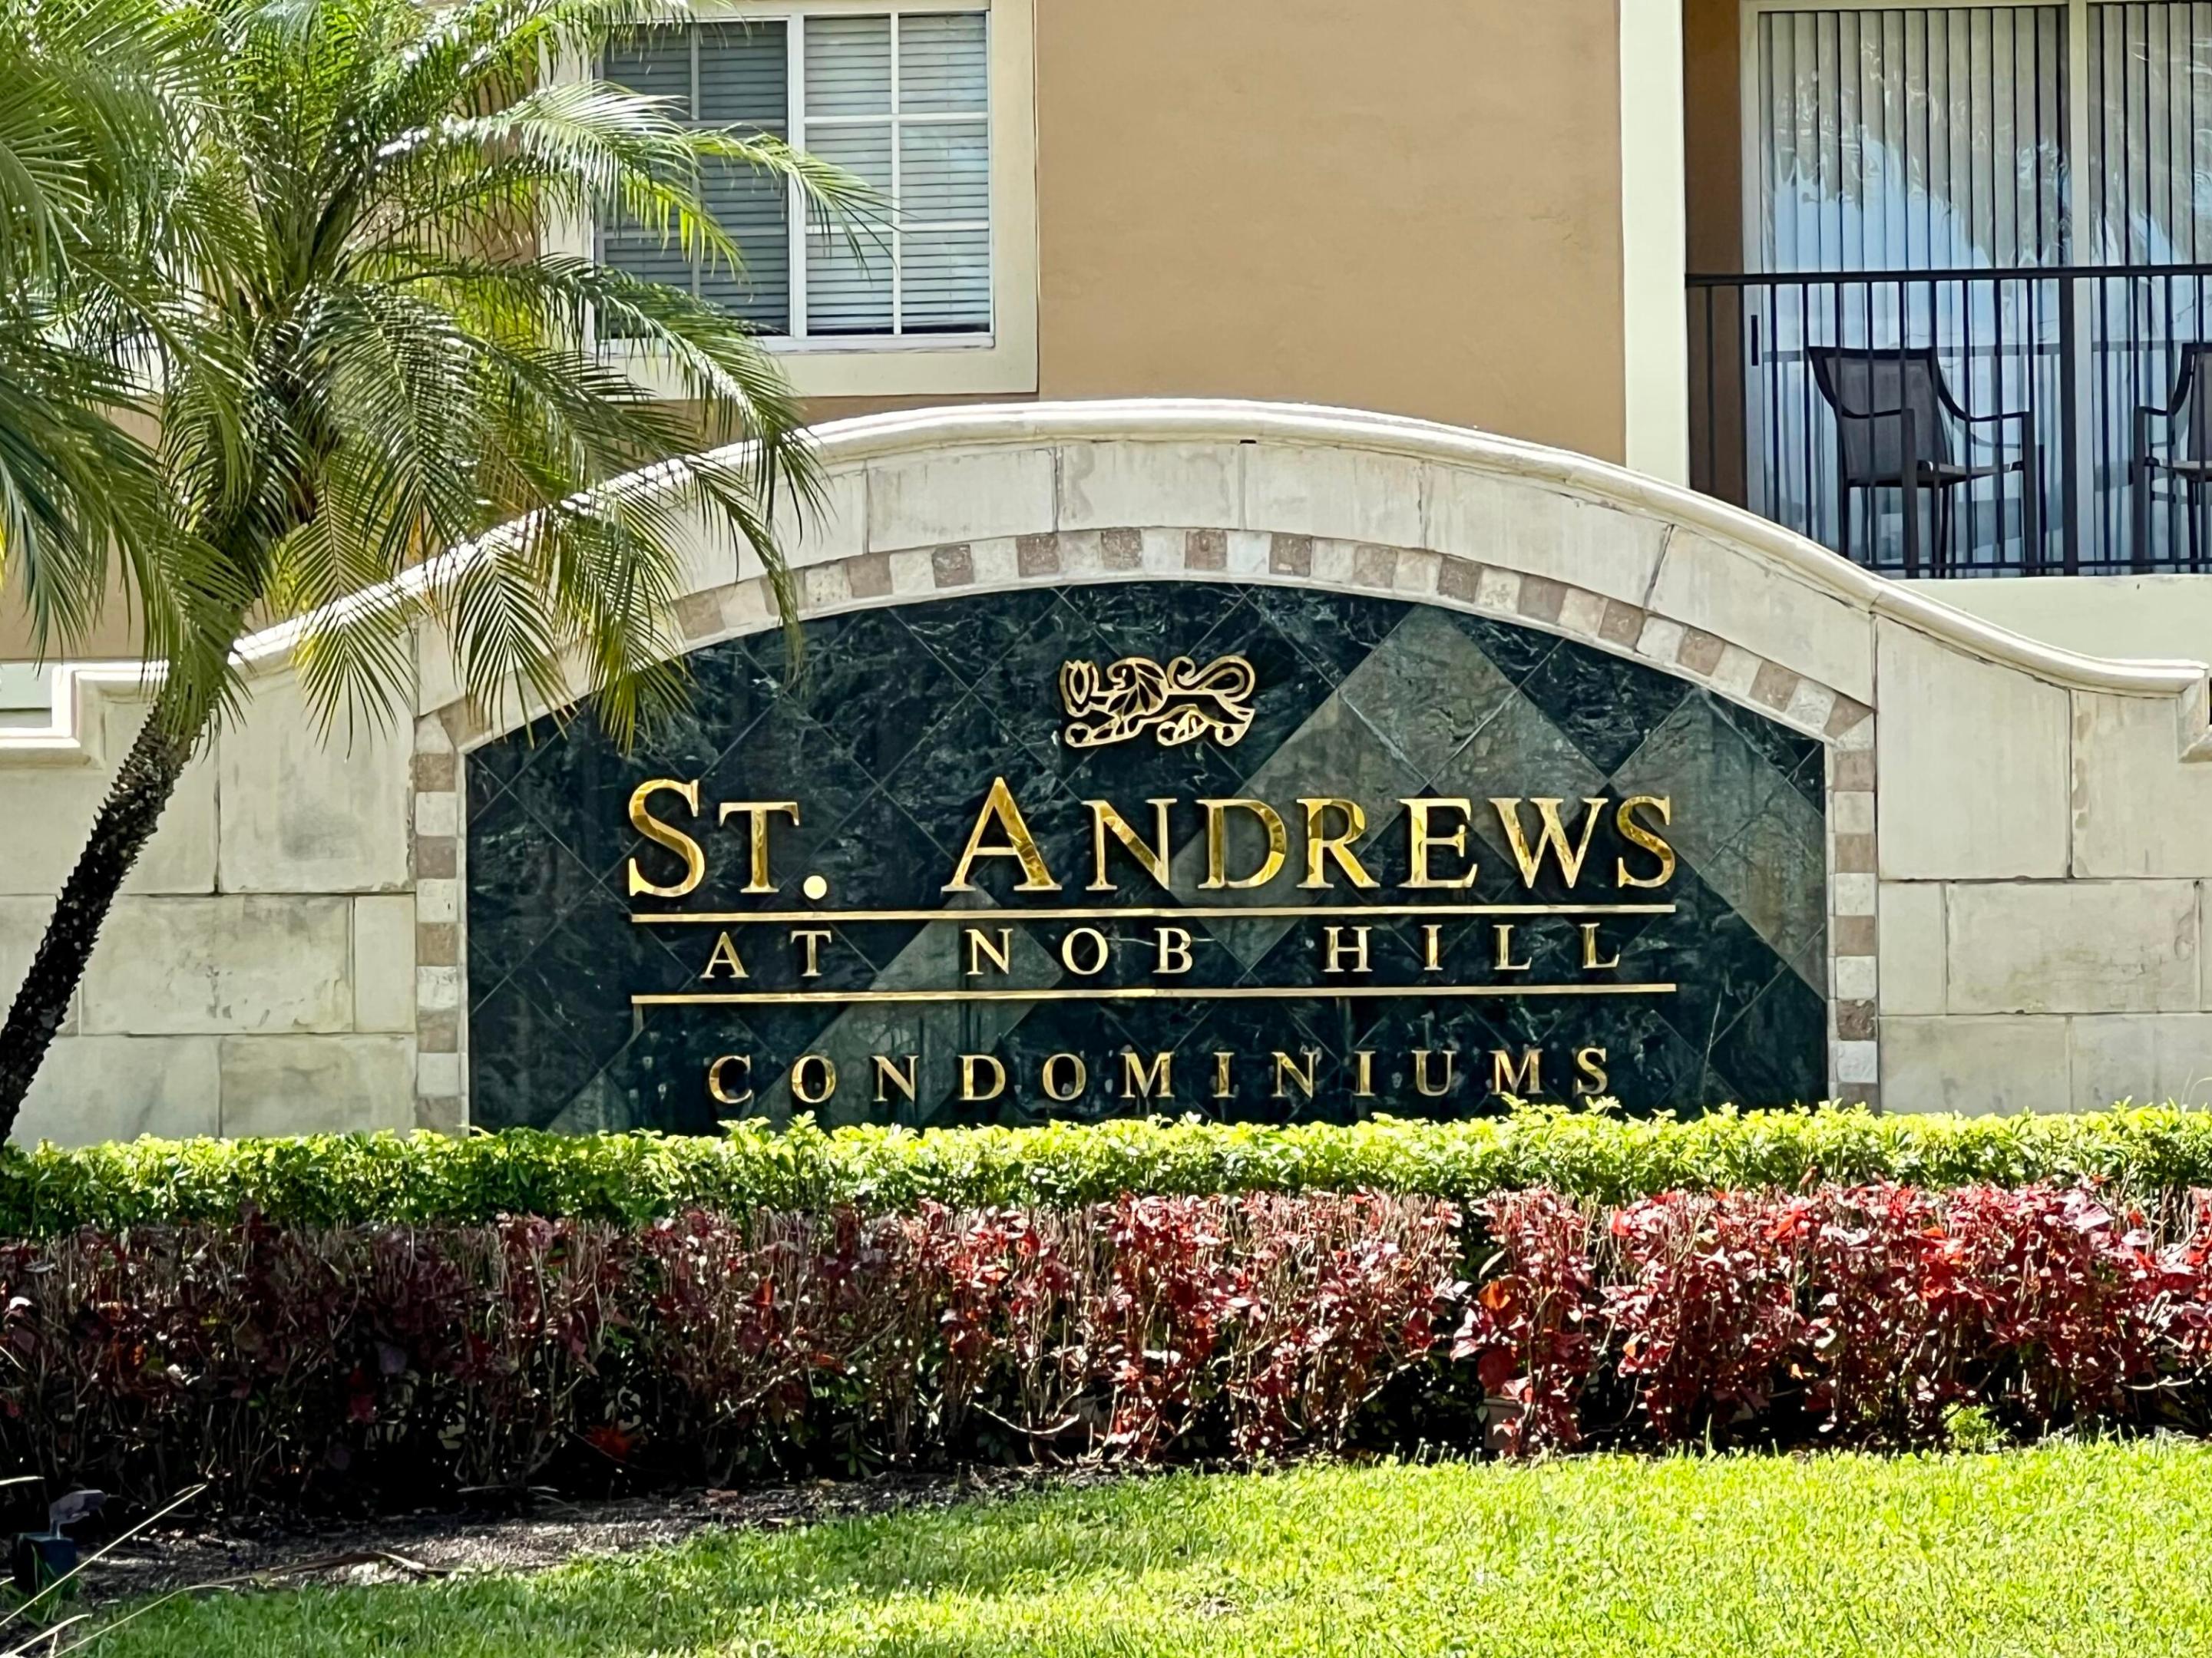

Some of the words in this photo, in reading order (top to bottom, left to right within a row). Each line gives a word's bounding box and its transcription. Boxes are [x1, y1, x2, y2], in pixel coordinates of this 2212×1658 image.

[628, 778, 828, 900] ST.
[941, 776, 1676, 893] ANDREWS
[699, 930, 832, 979] AT
[964, 926, 1194, 976] NOB
[1323, 923, 1621, 973] HILL
[709, 1047, 1609, 1104] CONDOMINIUMS
